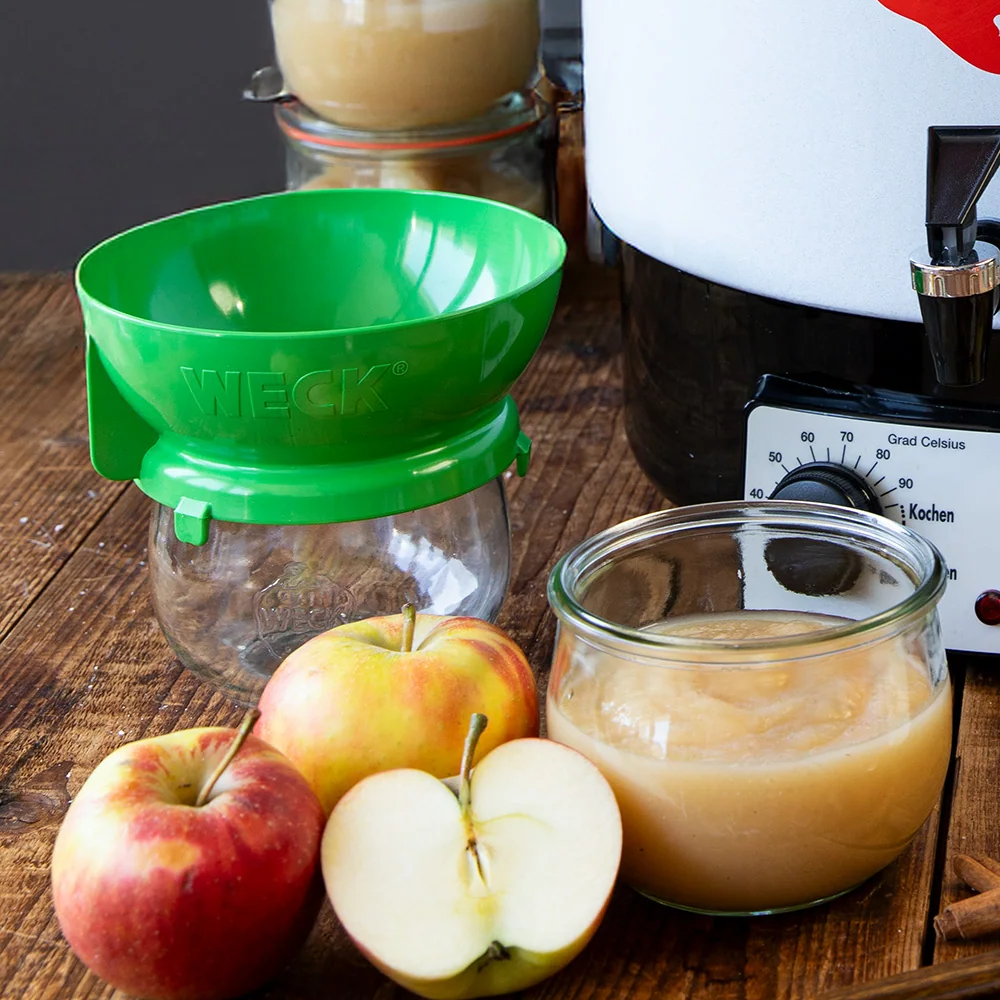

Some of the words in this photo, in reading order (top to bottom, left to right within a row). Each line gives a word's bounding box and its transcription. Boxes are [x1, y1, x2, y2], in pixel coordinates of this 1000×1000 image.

[800, 431, 815, 443] 60
[839, 431, 854, 442] 70
[887, 433, 917, 447] Grad
[920, 436, 966, 450] Celsius
[768, 451, 783, 463] 50
[875, 448, 891, 461] 80
[898, 477, 914, 490] 90
[749, 488, 764, 499] 40
[908, 503, 955, 523] Kochen
